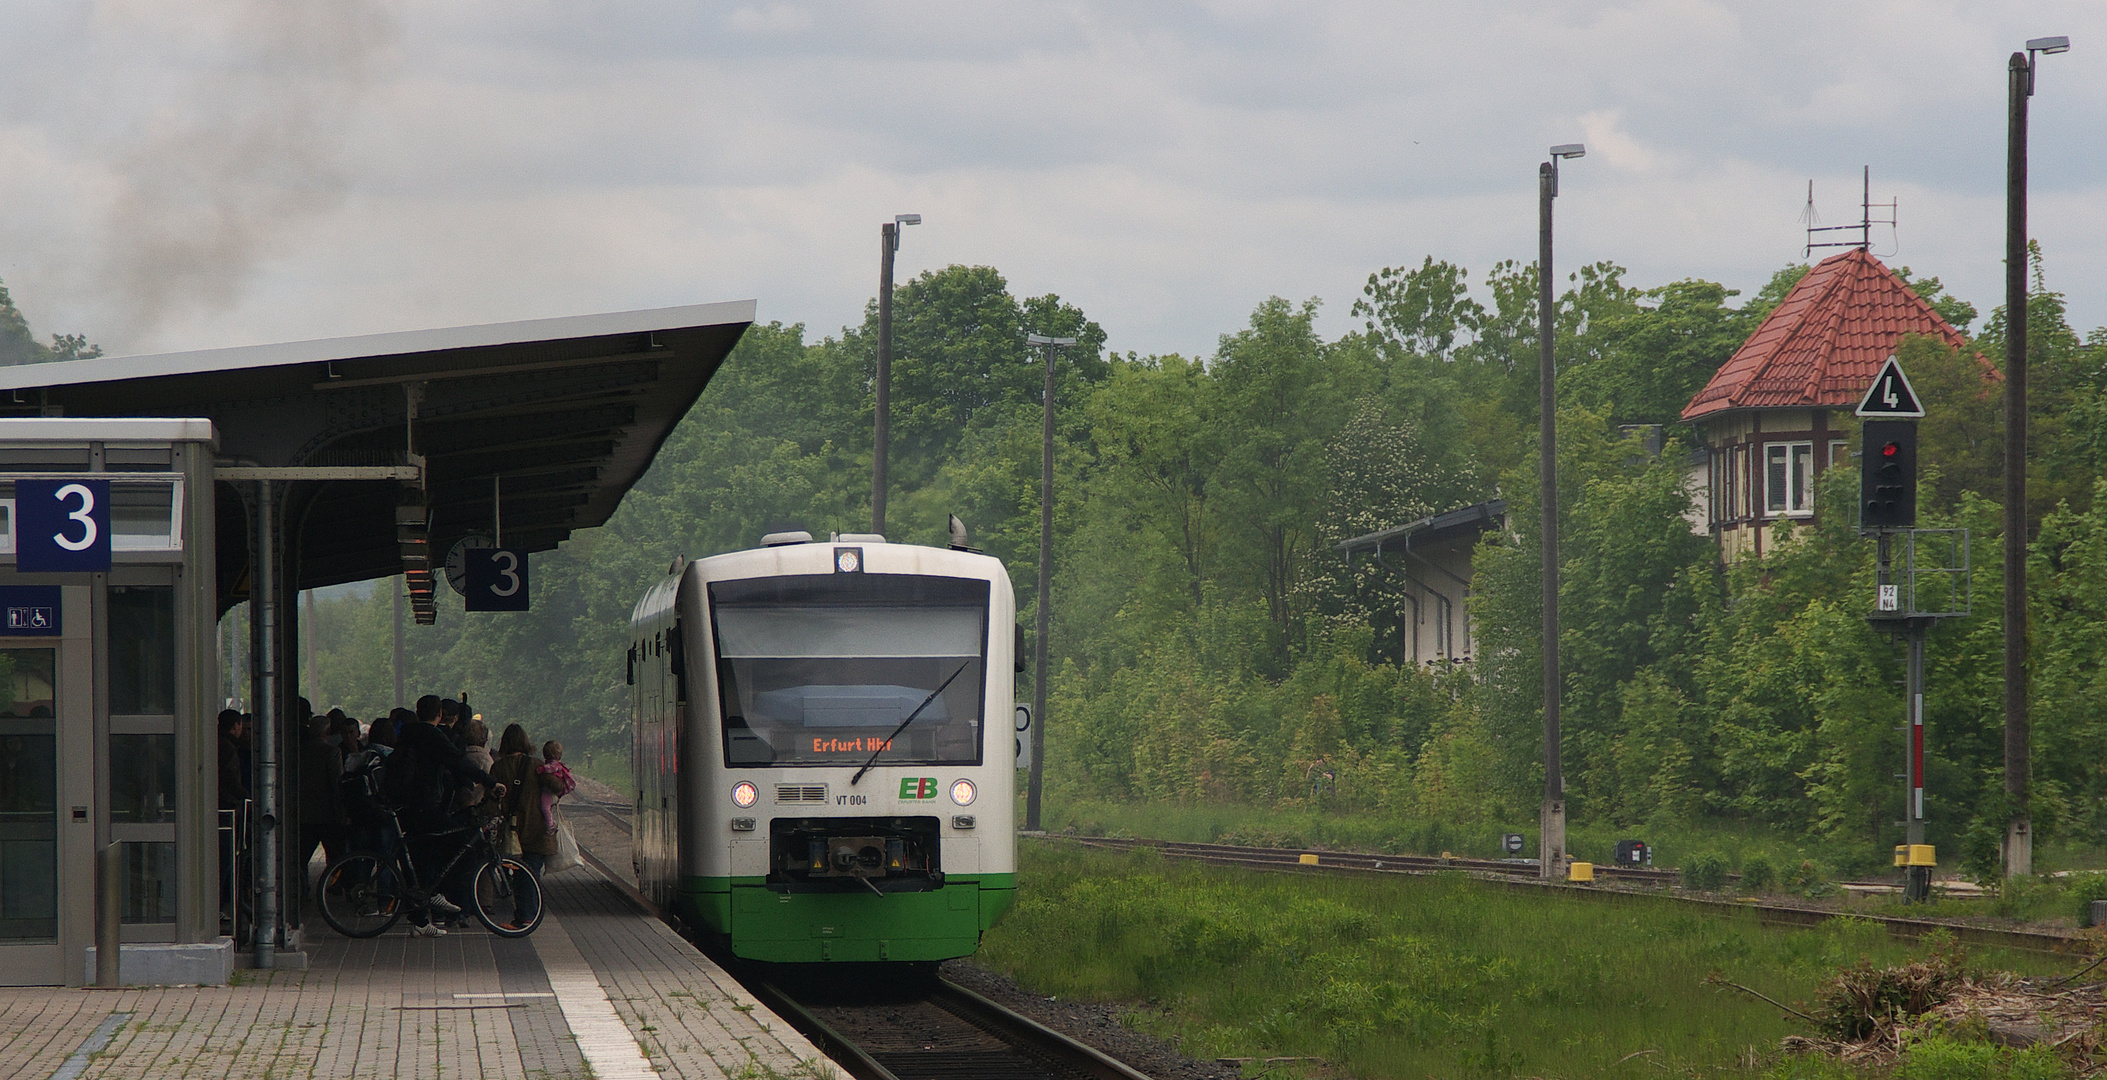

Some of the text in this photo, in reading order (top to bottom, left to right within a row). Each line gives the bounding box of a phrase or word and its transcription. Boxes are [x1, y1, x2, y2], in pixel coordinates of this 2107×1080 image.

[1883, 375, 1899, 408] 4
[53, 483, 97, 551] 3
[489, 550, 520, 597] 3
[1883, 586, 1895, 597] 92
[1882, 599, 1895, 610] N4
[813, 737, 893, 752] Erfurt Hbf
[899, 777, 938, 799] EB
[836, 795, 867, 806] VT 004
